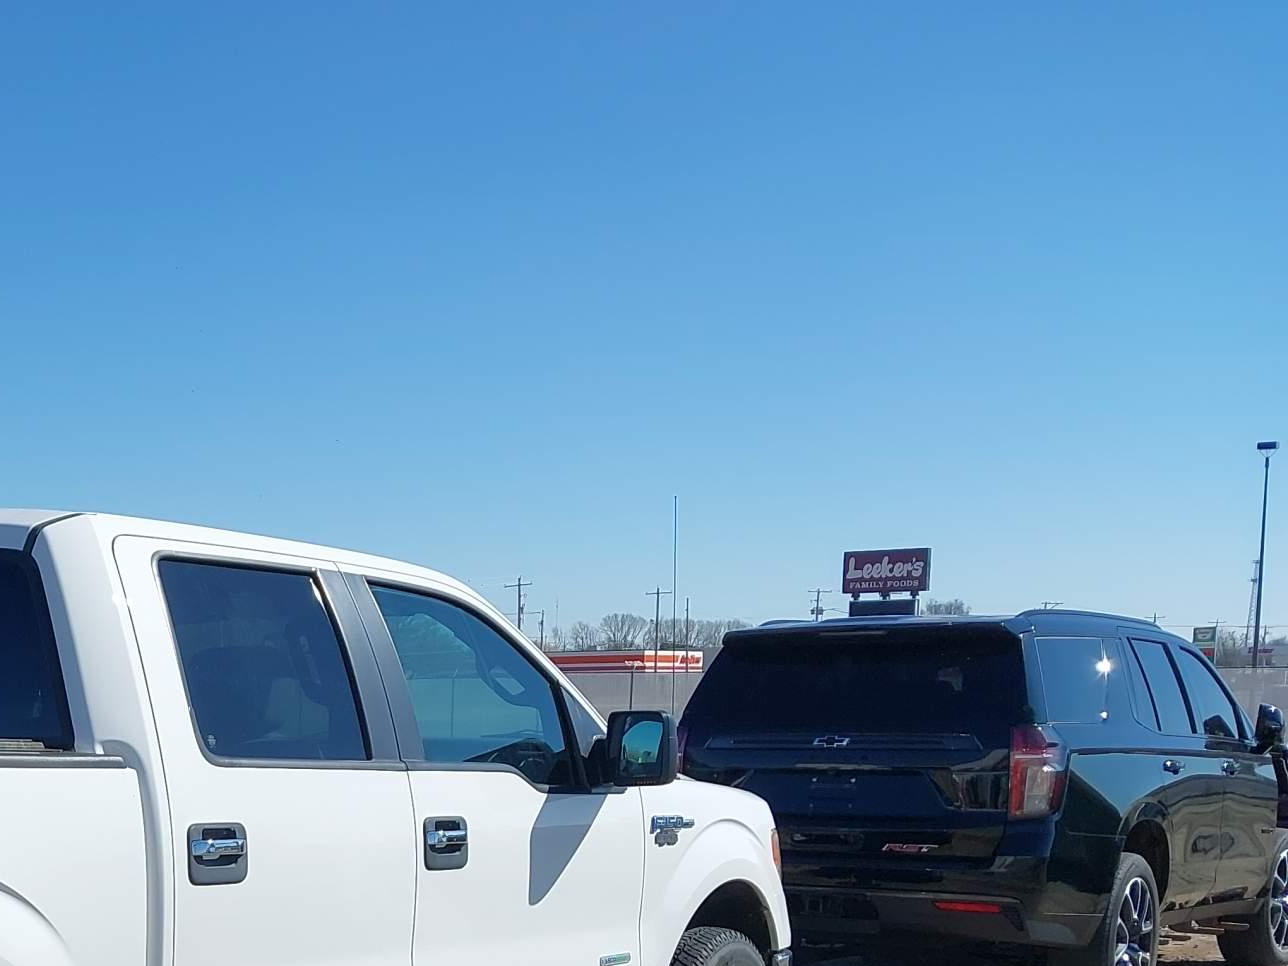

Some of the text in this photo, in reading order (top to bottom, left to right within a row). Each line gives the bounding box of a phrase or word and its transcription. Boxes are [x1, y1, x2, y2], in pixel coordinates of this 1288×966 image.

[846, 556, 924, 579] Leeker's
[849, 580, 919, 590] FAMILY FOODS
